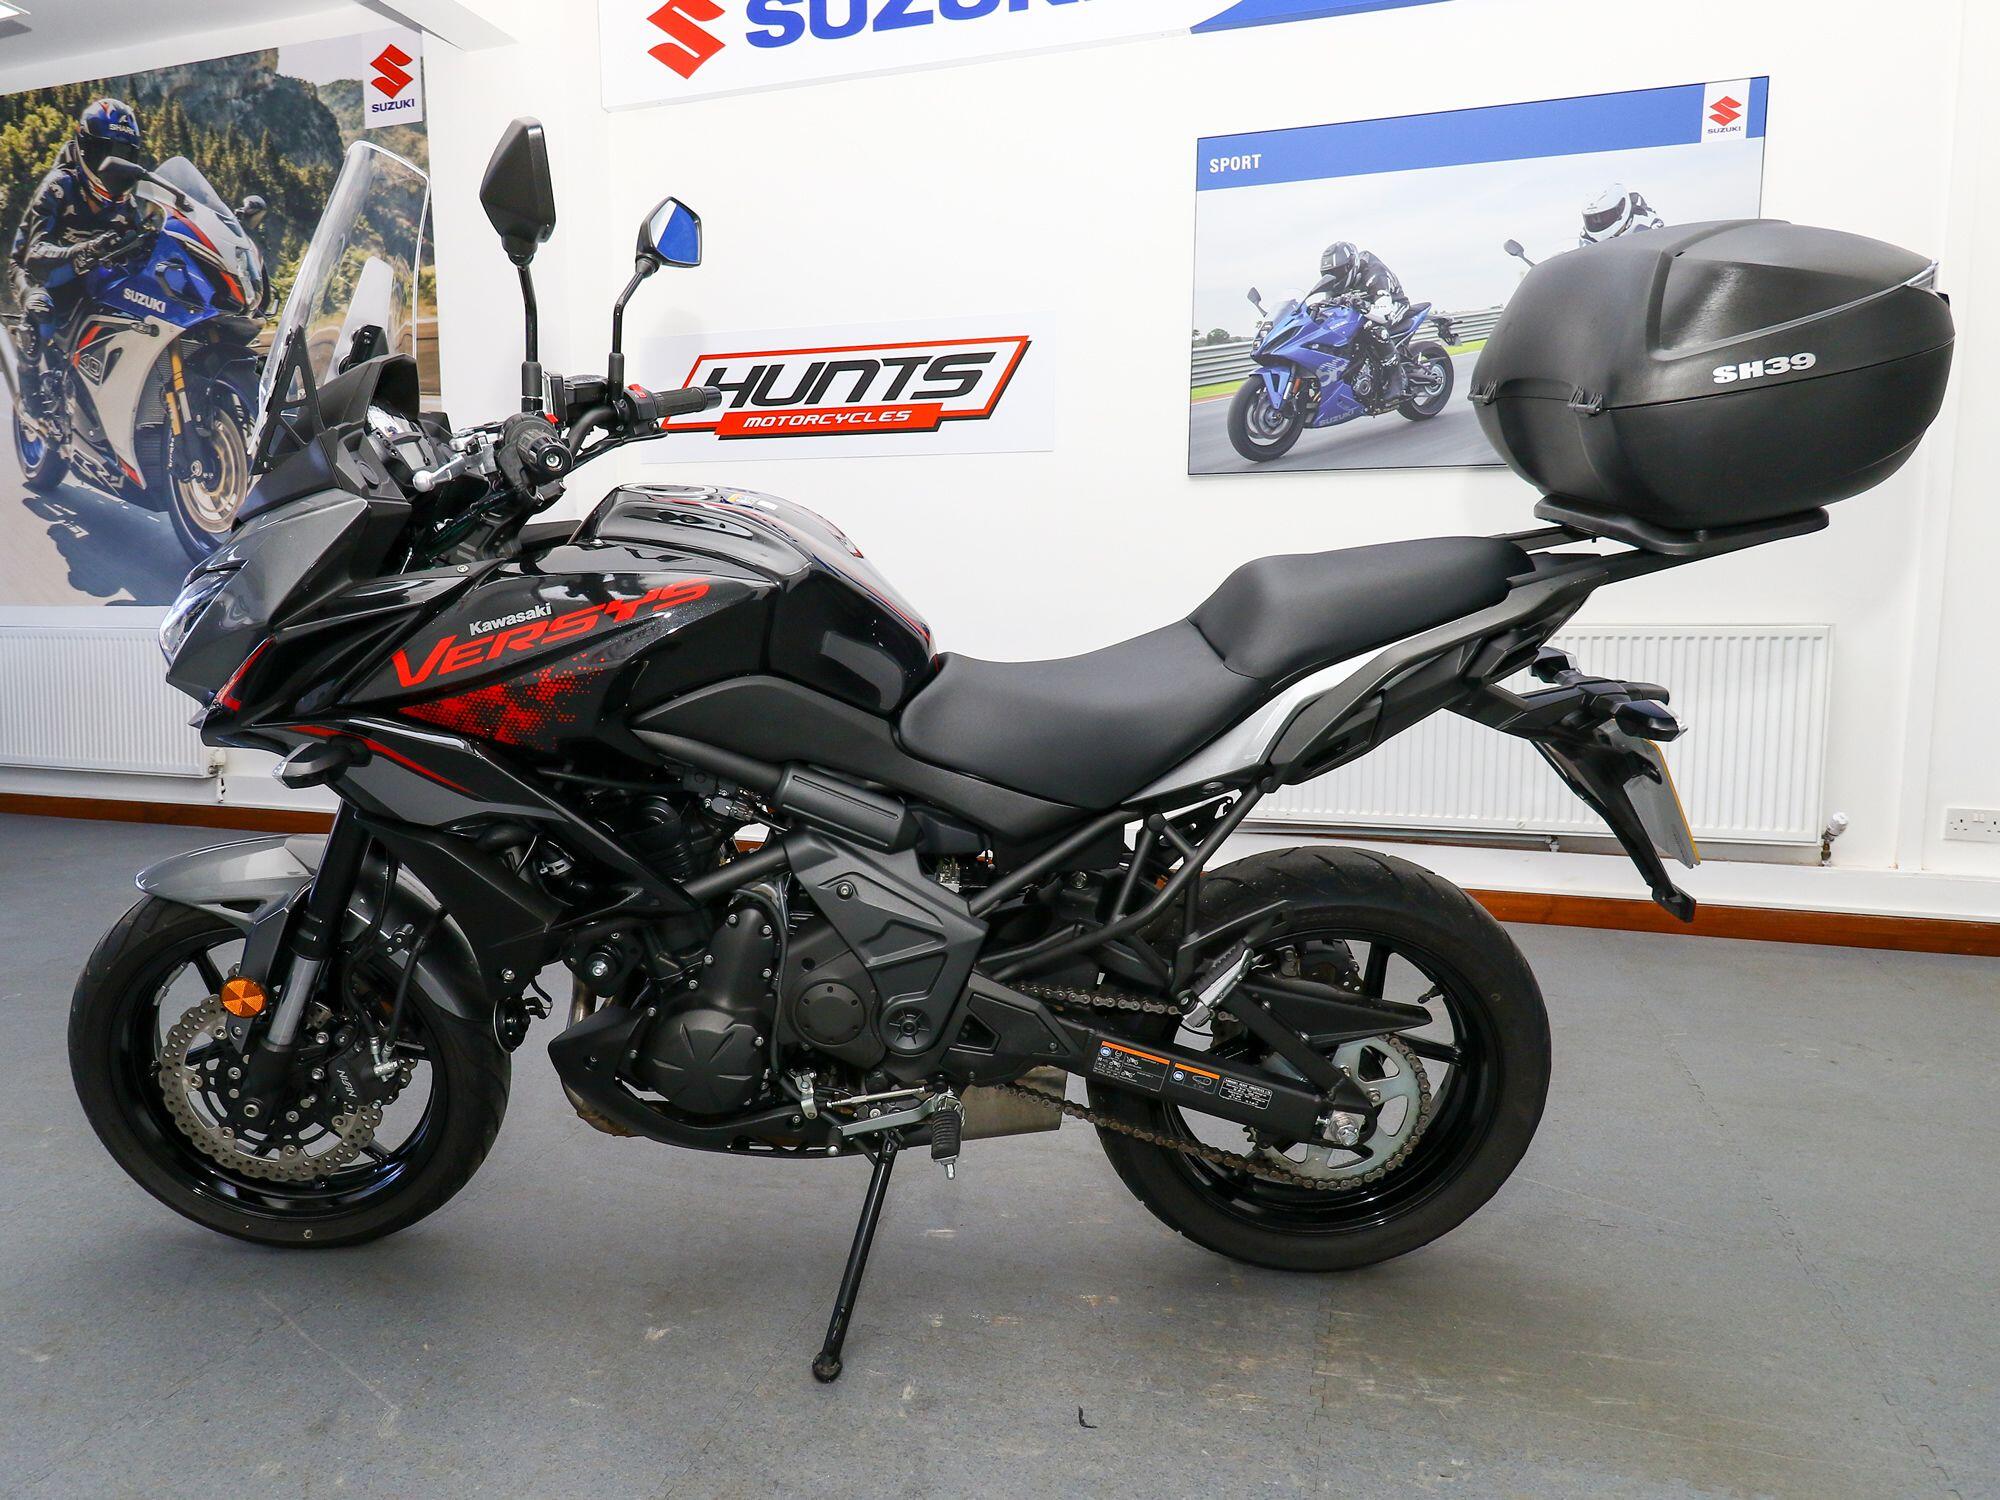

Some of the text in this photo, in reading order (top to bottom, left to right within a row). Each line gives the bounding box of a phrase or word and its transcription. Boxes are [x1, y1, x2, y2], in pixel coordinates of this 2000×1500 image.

[371, 98, 415, 113] SUZUKI
[1707, 126, 1742, 135] SUZUKI
[1209, 153, 1262, 174] SPORT
[123, 287, 166, 314] SUZUKI
[704, 351, 997, 408] HUNTS
[1712, 352, 1817, 384] SH39
[742, 410, 913, 429] MOTORCYCLES
[391, 577, 711, 688] VERSYS
[469, 602, 552, 636] Kawasaki
